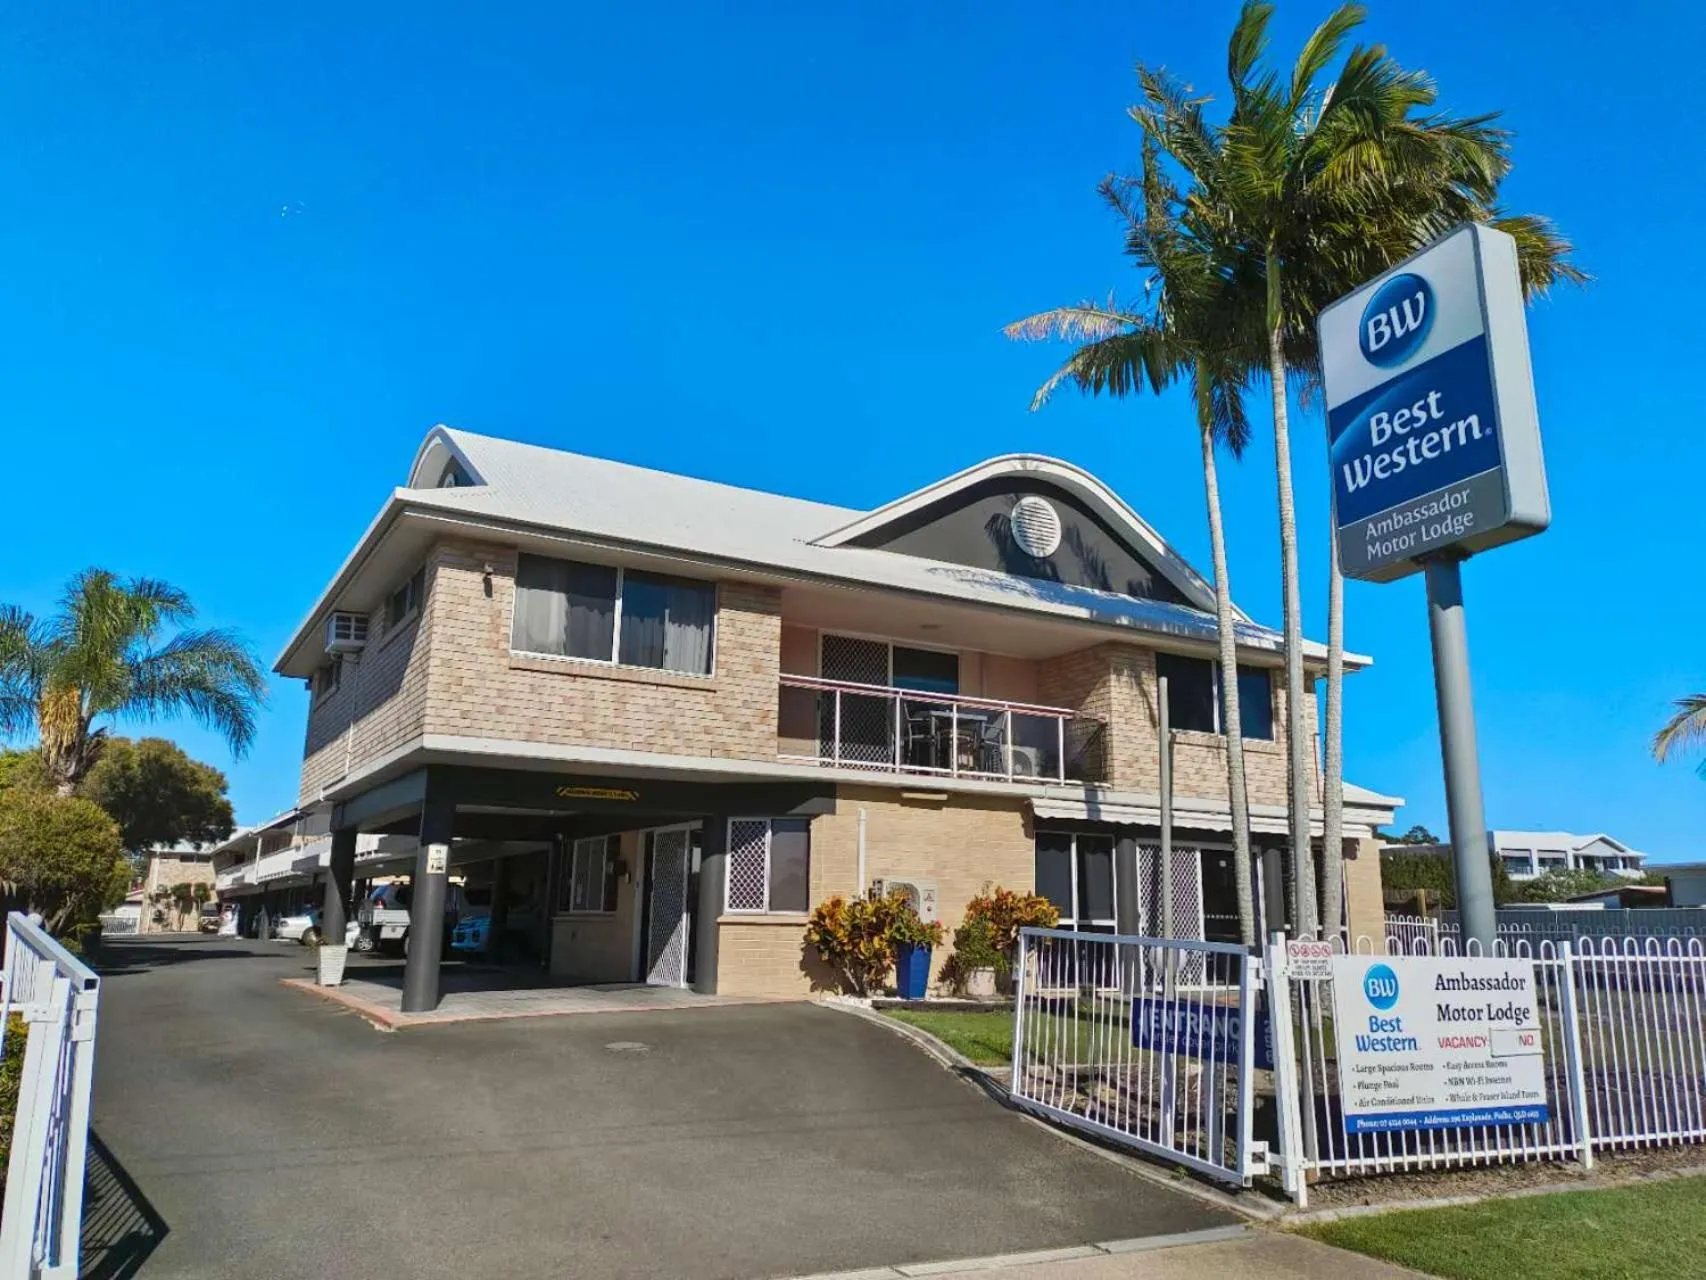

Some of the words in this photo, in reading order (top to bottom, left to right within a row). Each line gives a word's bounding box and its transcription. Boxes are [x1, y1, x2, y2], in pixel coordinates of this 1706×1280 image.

[1368, 291, 1425, 352] BW
[1369, 389, 1444, 447] Best
[1342, 414, 1482, 493] Western
[1366, 489, 1470, 540] Ambassador
[1367, 531, 1417, 560] Motor
[1421, 512, 1474, 541] Lodge
[1368, 978, 1396, 997] BW
[1435, 971, 1526, 991] Ambassador
[1436, 1003, 1483, 1022] Motor
[1486, 1001, 1530, 1026] Lodge
[1150, 1007, 1240, 1040] ENTRANC
[1369, 1015, 1403, 1033] Best
[1355, 1033, 1418, 1052] Western
[1438, 1036, 1488, 1048] VACANCY
[1519, 1034, 1534, 1046] NO
[1355, 1064, 1376, 1074] Large
[1377, 1062, 1409, 1076] Spacious
[1409, 1062, 1434, 1071] Rooms
[1446, 1061, 1461, 1071] Easy
[1357, 1080, 1382, 1091] Plunge
[1359, 1098, 1370, 1107] Air
